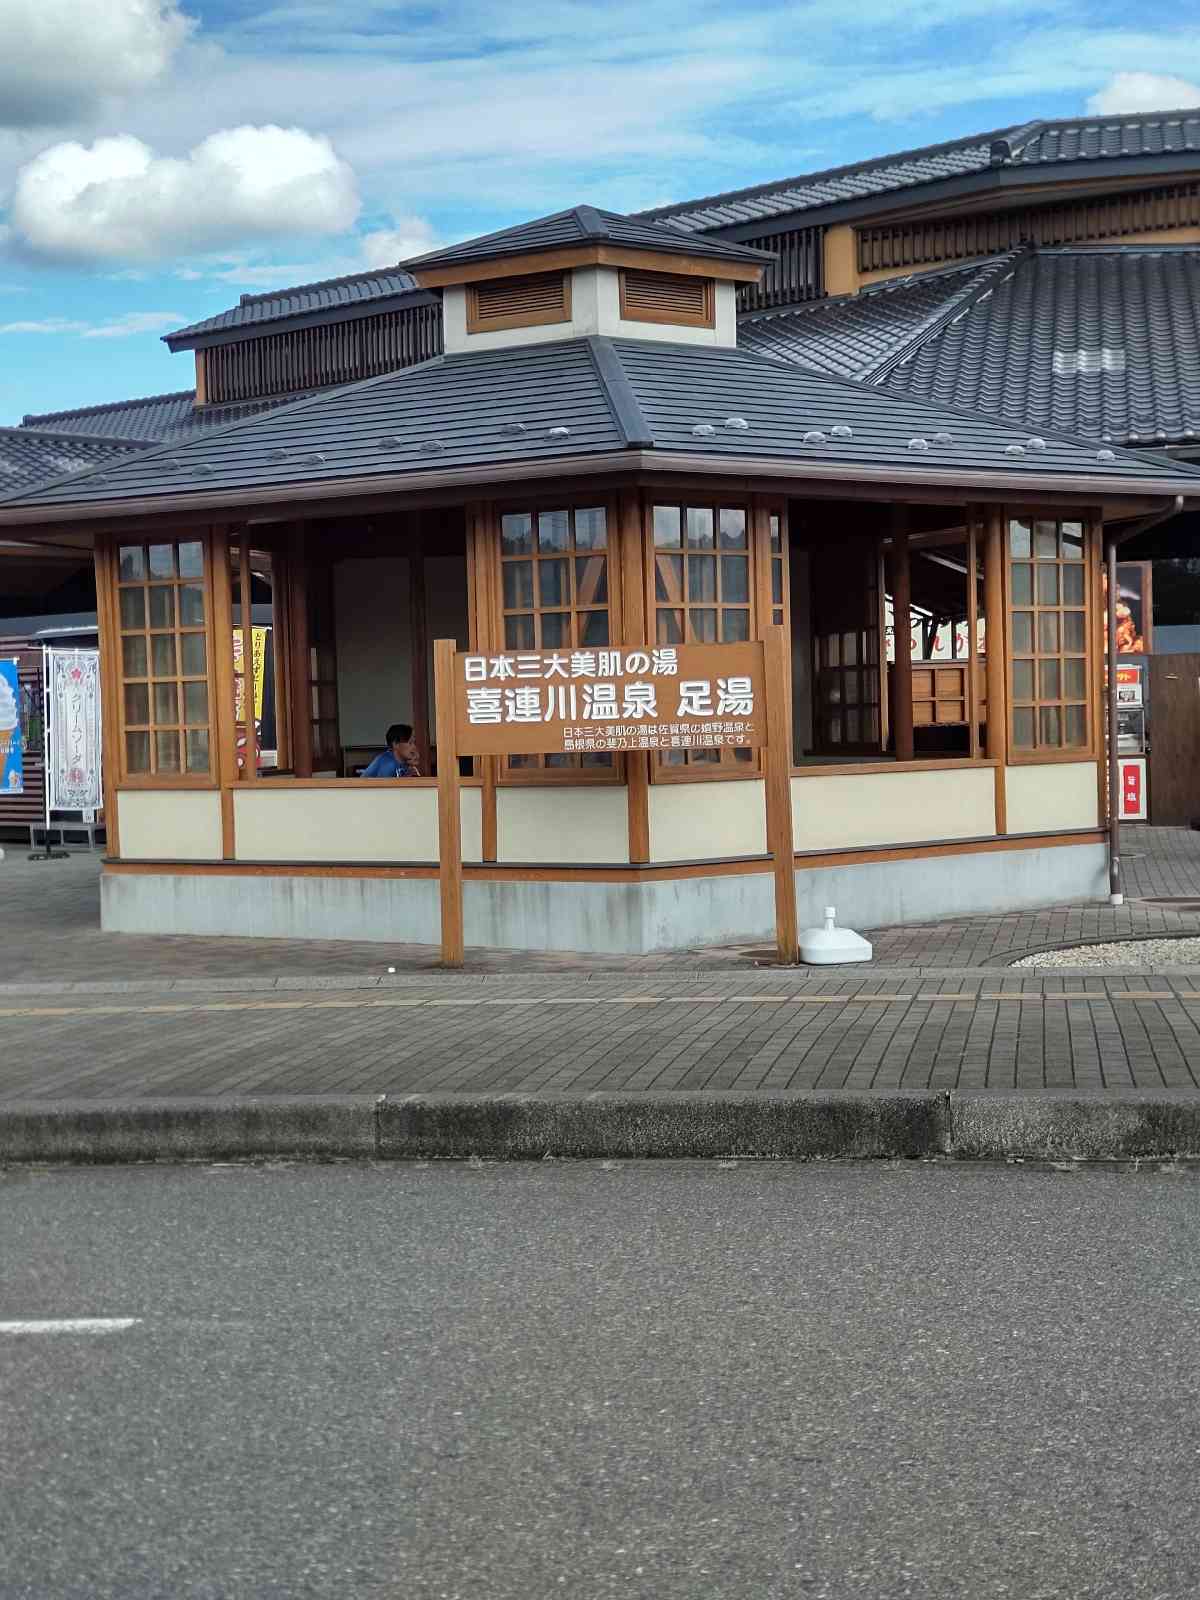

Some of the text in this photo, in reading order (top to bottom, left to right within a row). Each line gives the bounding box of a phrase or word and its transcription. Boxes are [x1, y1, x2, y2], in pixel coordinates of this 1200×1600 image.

[464, 648, 678, 682] 日本三大美肌の湯
[466, 677, 754, 724] 喜連川温泉 足湯
